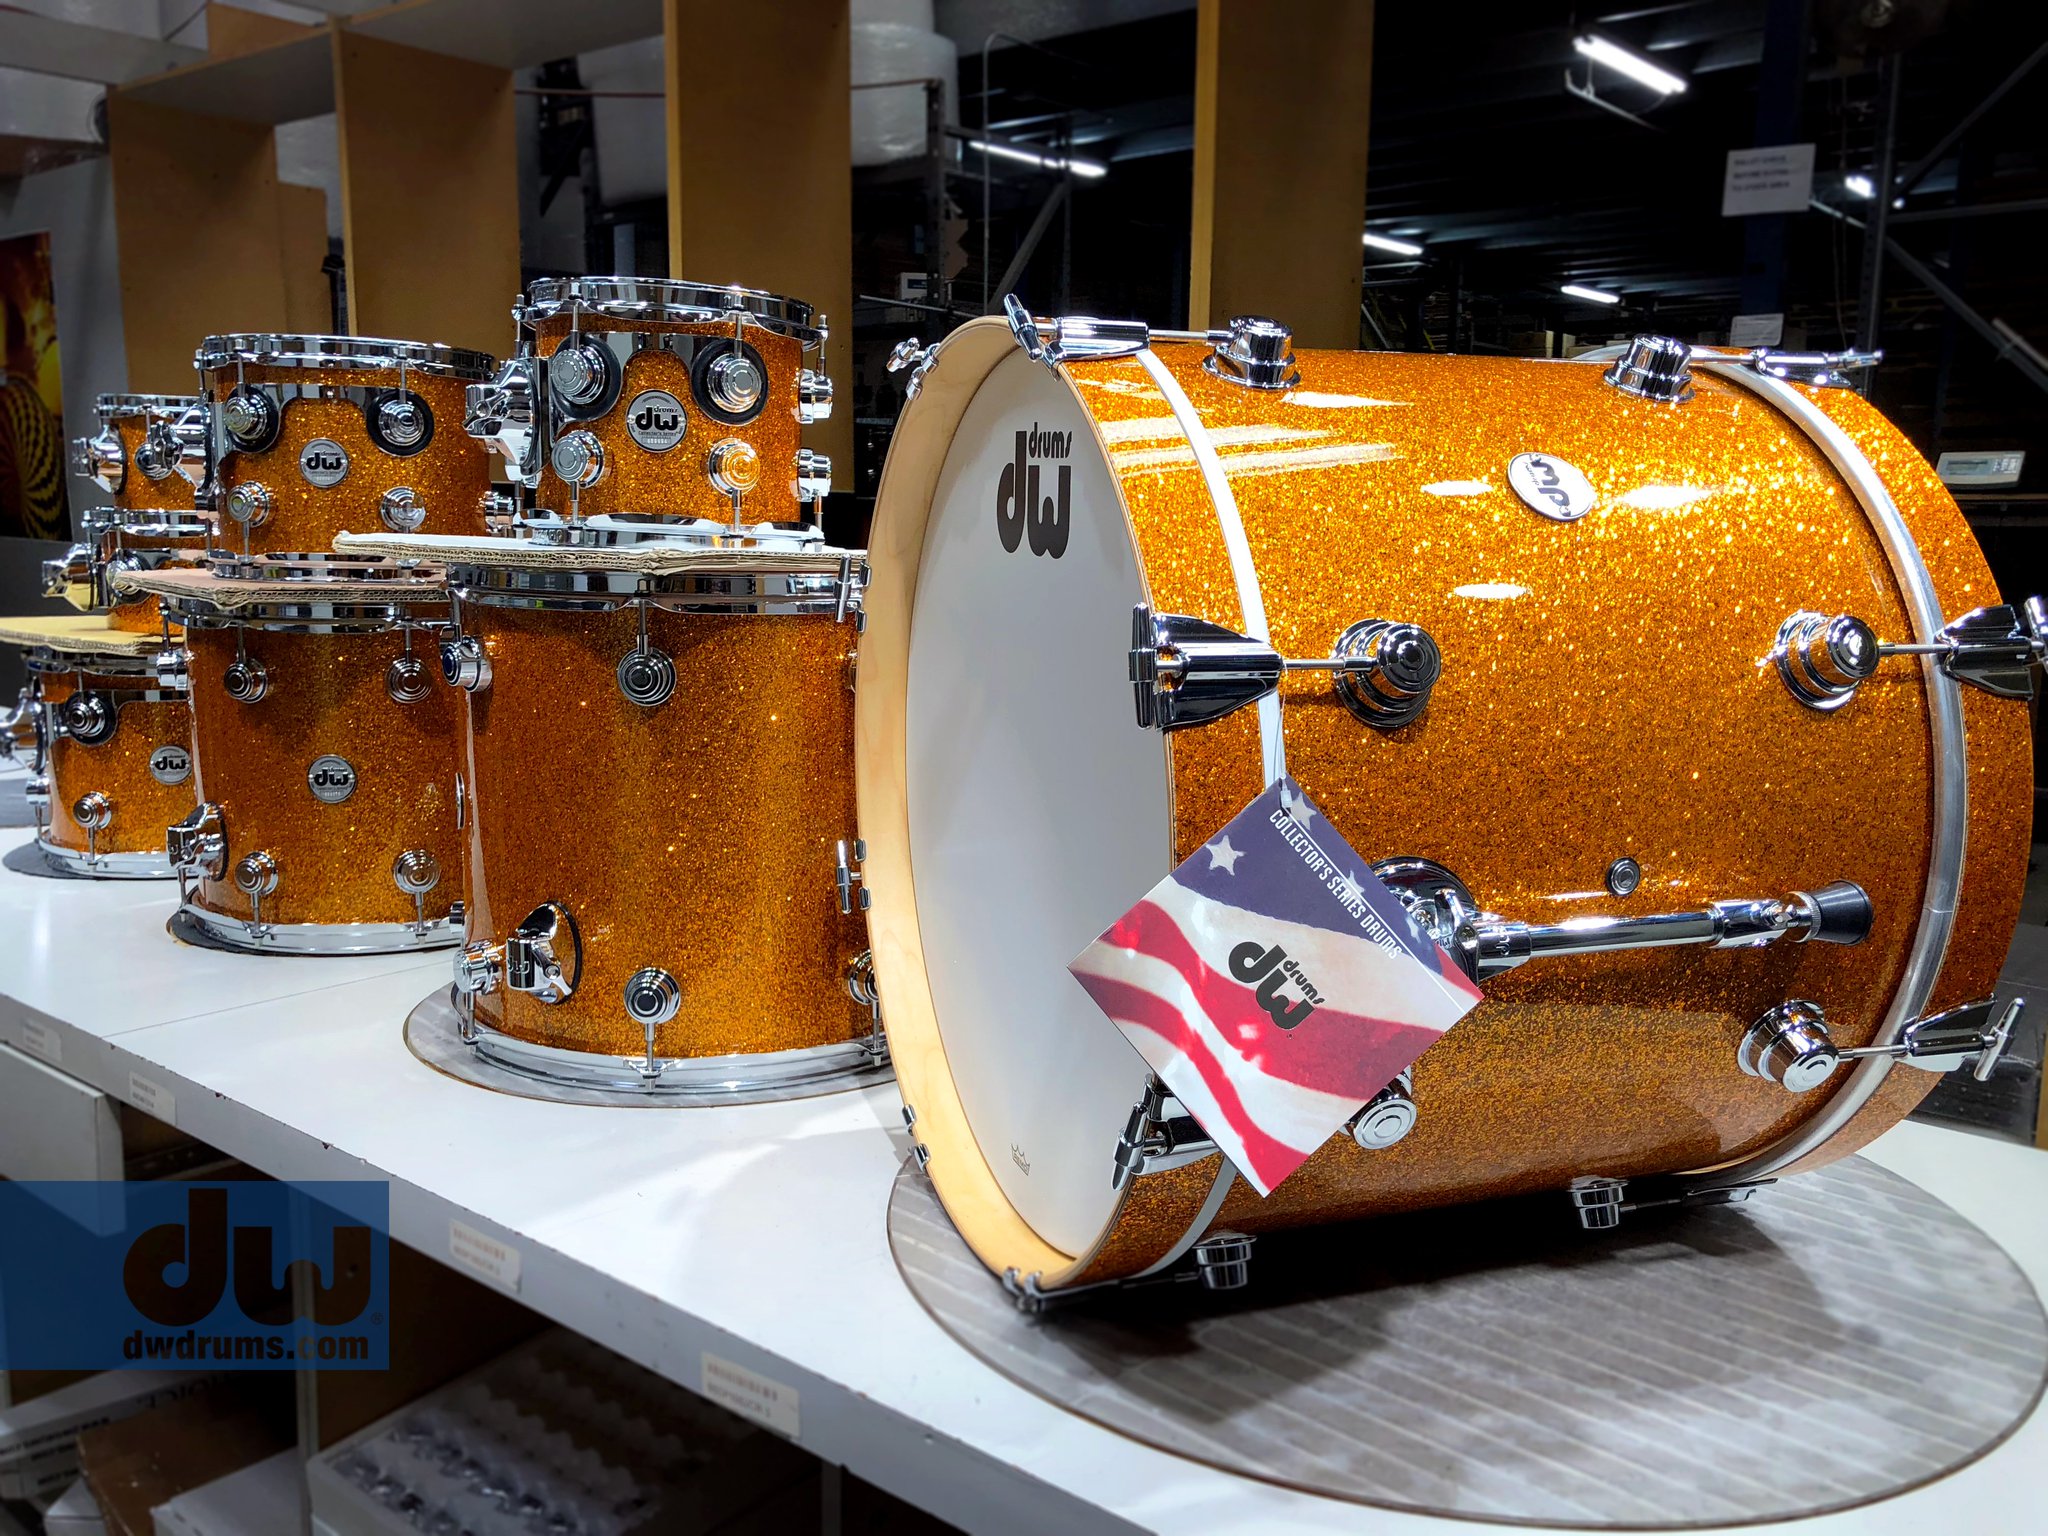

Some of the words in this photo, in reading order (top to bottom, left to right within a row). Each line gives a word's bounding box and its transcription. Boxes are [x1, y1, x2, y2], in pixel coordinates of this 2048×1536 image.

[635, 407, 678, 431] dw
[653, 404, 678, 413] drums
[1028, 421, 1073, 459] drums
[306, 452, 342, 470] dw
[996, 430, 1072, 560] dw
[154, 756, 187, 770] dw
[313, 769, 349, 787] dw
[1269, 808, 1333, 881] COLLECTOR'S
[1326, 875, 1367, 920] SERIES
[1359, 913, 1403, 960] DRUMS
[1228, 941, 1315, 1030] dw
[1282, 960, 1326, 1005] drums
